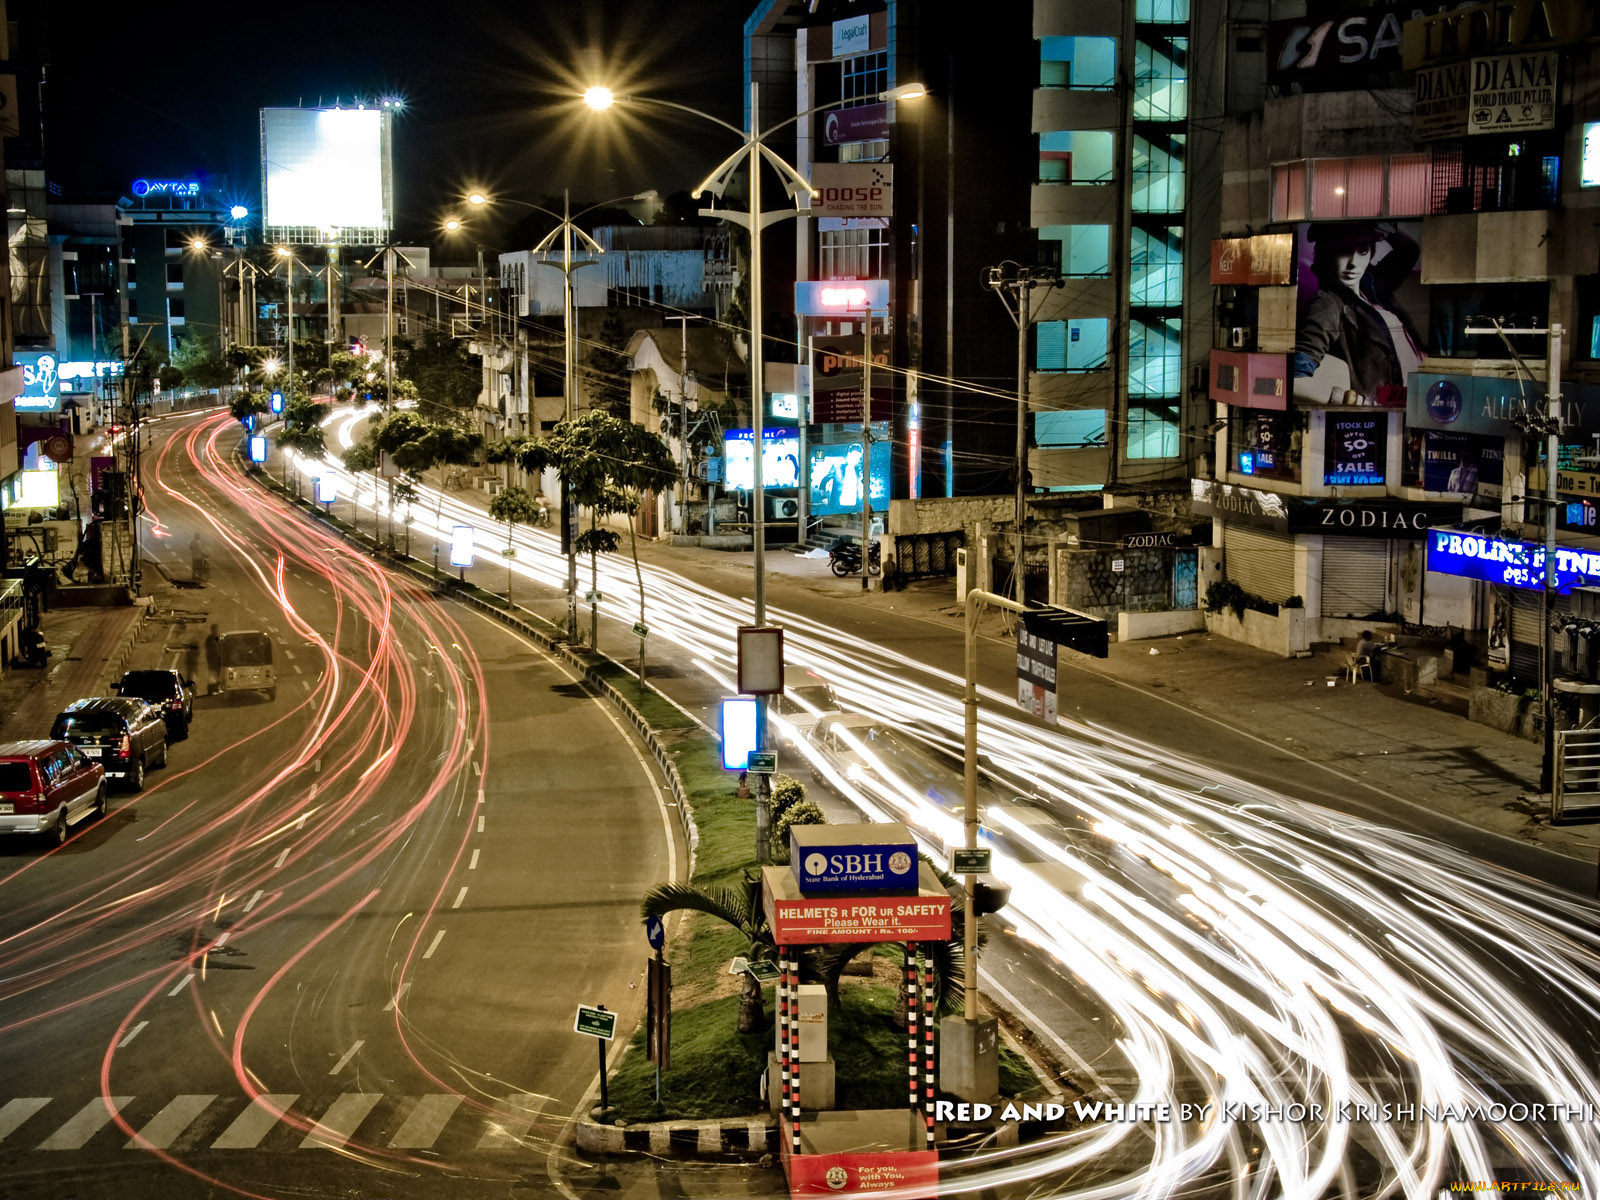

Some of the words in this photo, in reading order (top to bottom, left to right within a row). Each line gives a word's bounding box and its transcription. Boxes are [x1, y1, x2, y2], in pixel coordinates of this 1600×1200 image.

[1424, 0, 1557, 60] INDIA
[1474, 55, 1552, 92] DIANA
[1417, 66, 1468, 102] DIANA
[1473, 93, 1496, 108] WORLD
[1498, 91, 1522, 106] TRAVEL
[1523, 90, 1538, 105] PVT.
[1538, 88, 1553, 104] LTD.
[811, 187, 882, 207] goose
[1275, 378, 1283, 396] 21
[1482, 396, 1531, 419] ALLEN
[1336, 422, 1362, 430] STOCK
[1257, 453, 1273, 464] SALE
[1337, 462, 1375, 473] SALE
[1557, 472, 1574, 490] One
[1216, 492, 1257, 516] ZODIAC
[1321, 508, 1428, 530] ZODIAC
[1127, 534, 1176, 548] ZODIAC
[830, 853, 884, 875] SBH
[849, 873, 885, 882] Hyderabad
[779, 907, 838, 920] HELMETS
[841, 909, 849, 918] R
[851, 906, 877, 917] FOR
[880, 908, 894, 917] UR
[896, 904, 946, 916] SAFETY
[824, 917, 859, 928] Please
[862, 916, 888, 927] Wear
[891, 915, 902, 926] it.
[876, 1165, 897, 1174] you,
[883, 1172, 905, 1180] You,
[859, 1180, 895, 1189] Always
